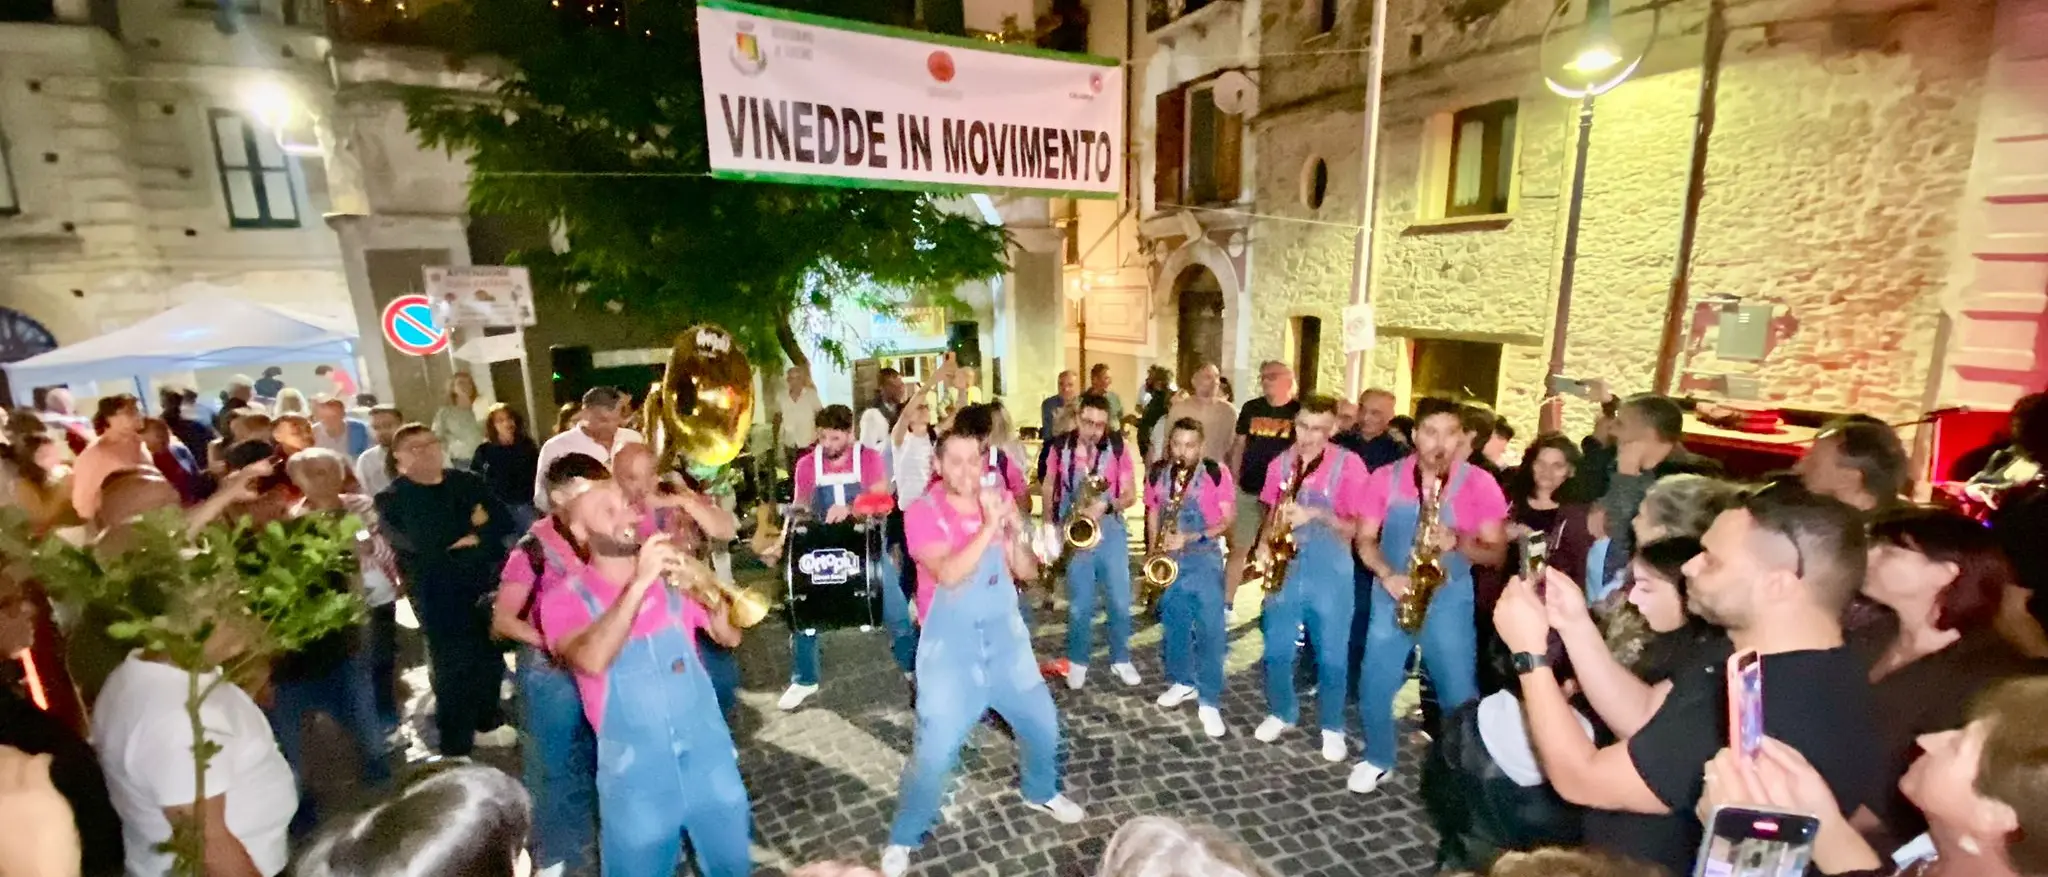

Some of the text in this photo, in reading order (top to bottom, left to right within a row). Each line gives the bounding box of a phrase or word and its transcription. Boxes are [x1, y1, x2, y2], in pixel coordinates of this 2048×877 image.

[720, 94, 1112, 182] VINEDDE IN MOVIMENTO
